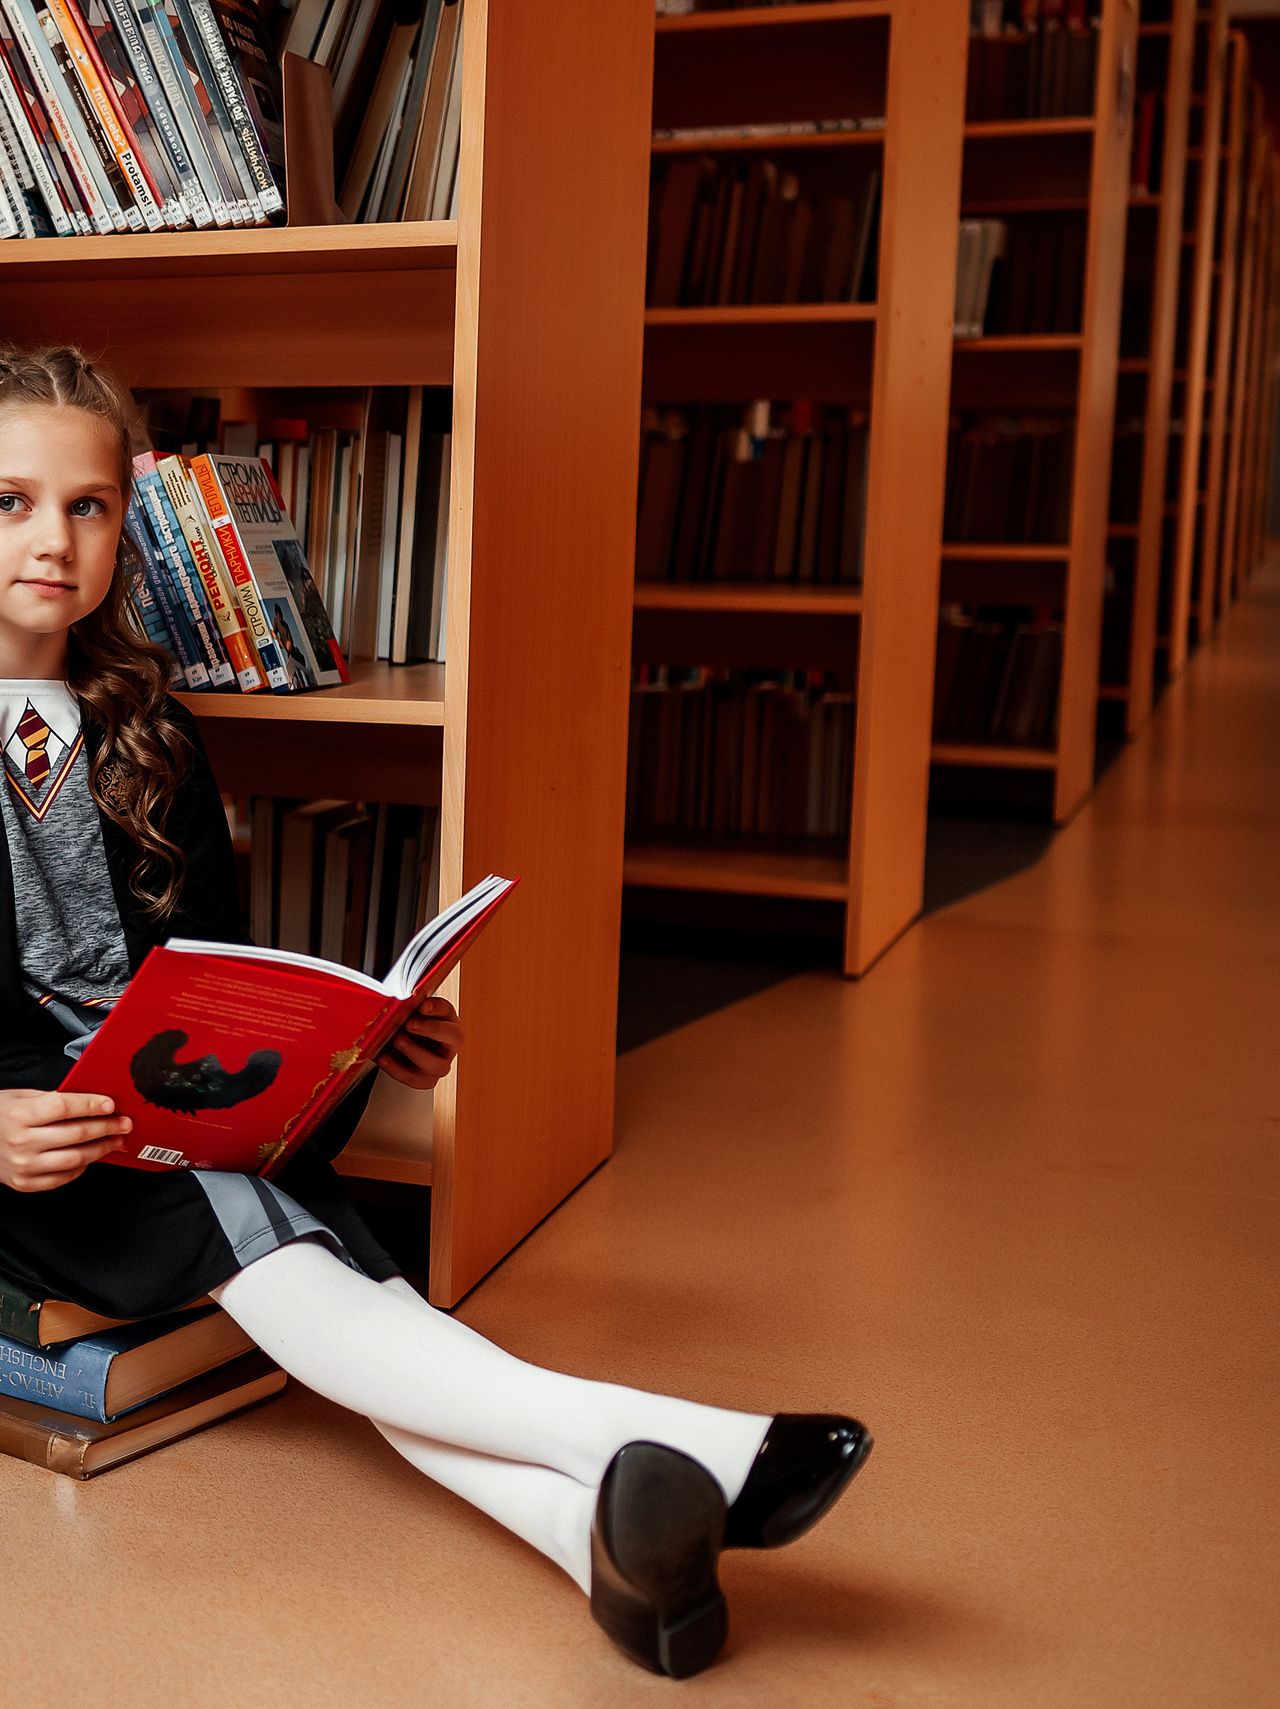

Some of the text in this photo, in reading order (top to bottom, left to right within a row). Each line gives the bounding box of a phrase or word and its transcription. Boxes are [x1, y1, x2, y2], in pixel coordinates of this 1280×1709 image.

[49, 100, 70, 139] INTERNETS
[91, 86, 126, 147] Internets?
[155, 100, 186, 167] vidusskolai
[122, 152, 152, 207] Protams!
[242, 127, 269, 189] МОУЧИТЕЛЬ
[195, 463, 224, 518] ТЕПЛИЦЫ
[190, 539, 225, 611] РЕМОНТ
[218, 526, 247, 587] ПАРНИКИ
[240, 586, 266, 637] СТРОИМ
[197, 621, 220, 668] правочник
